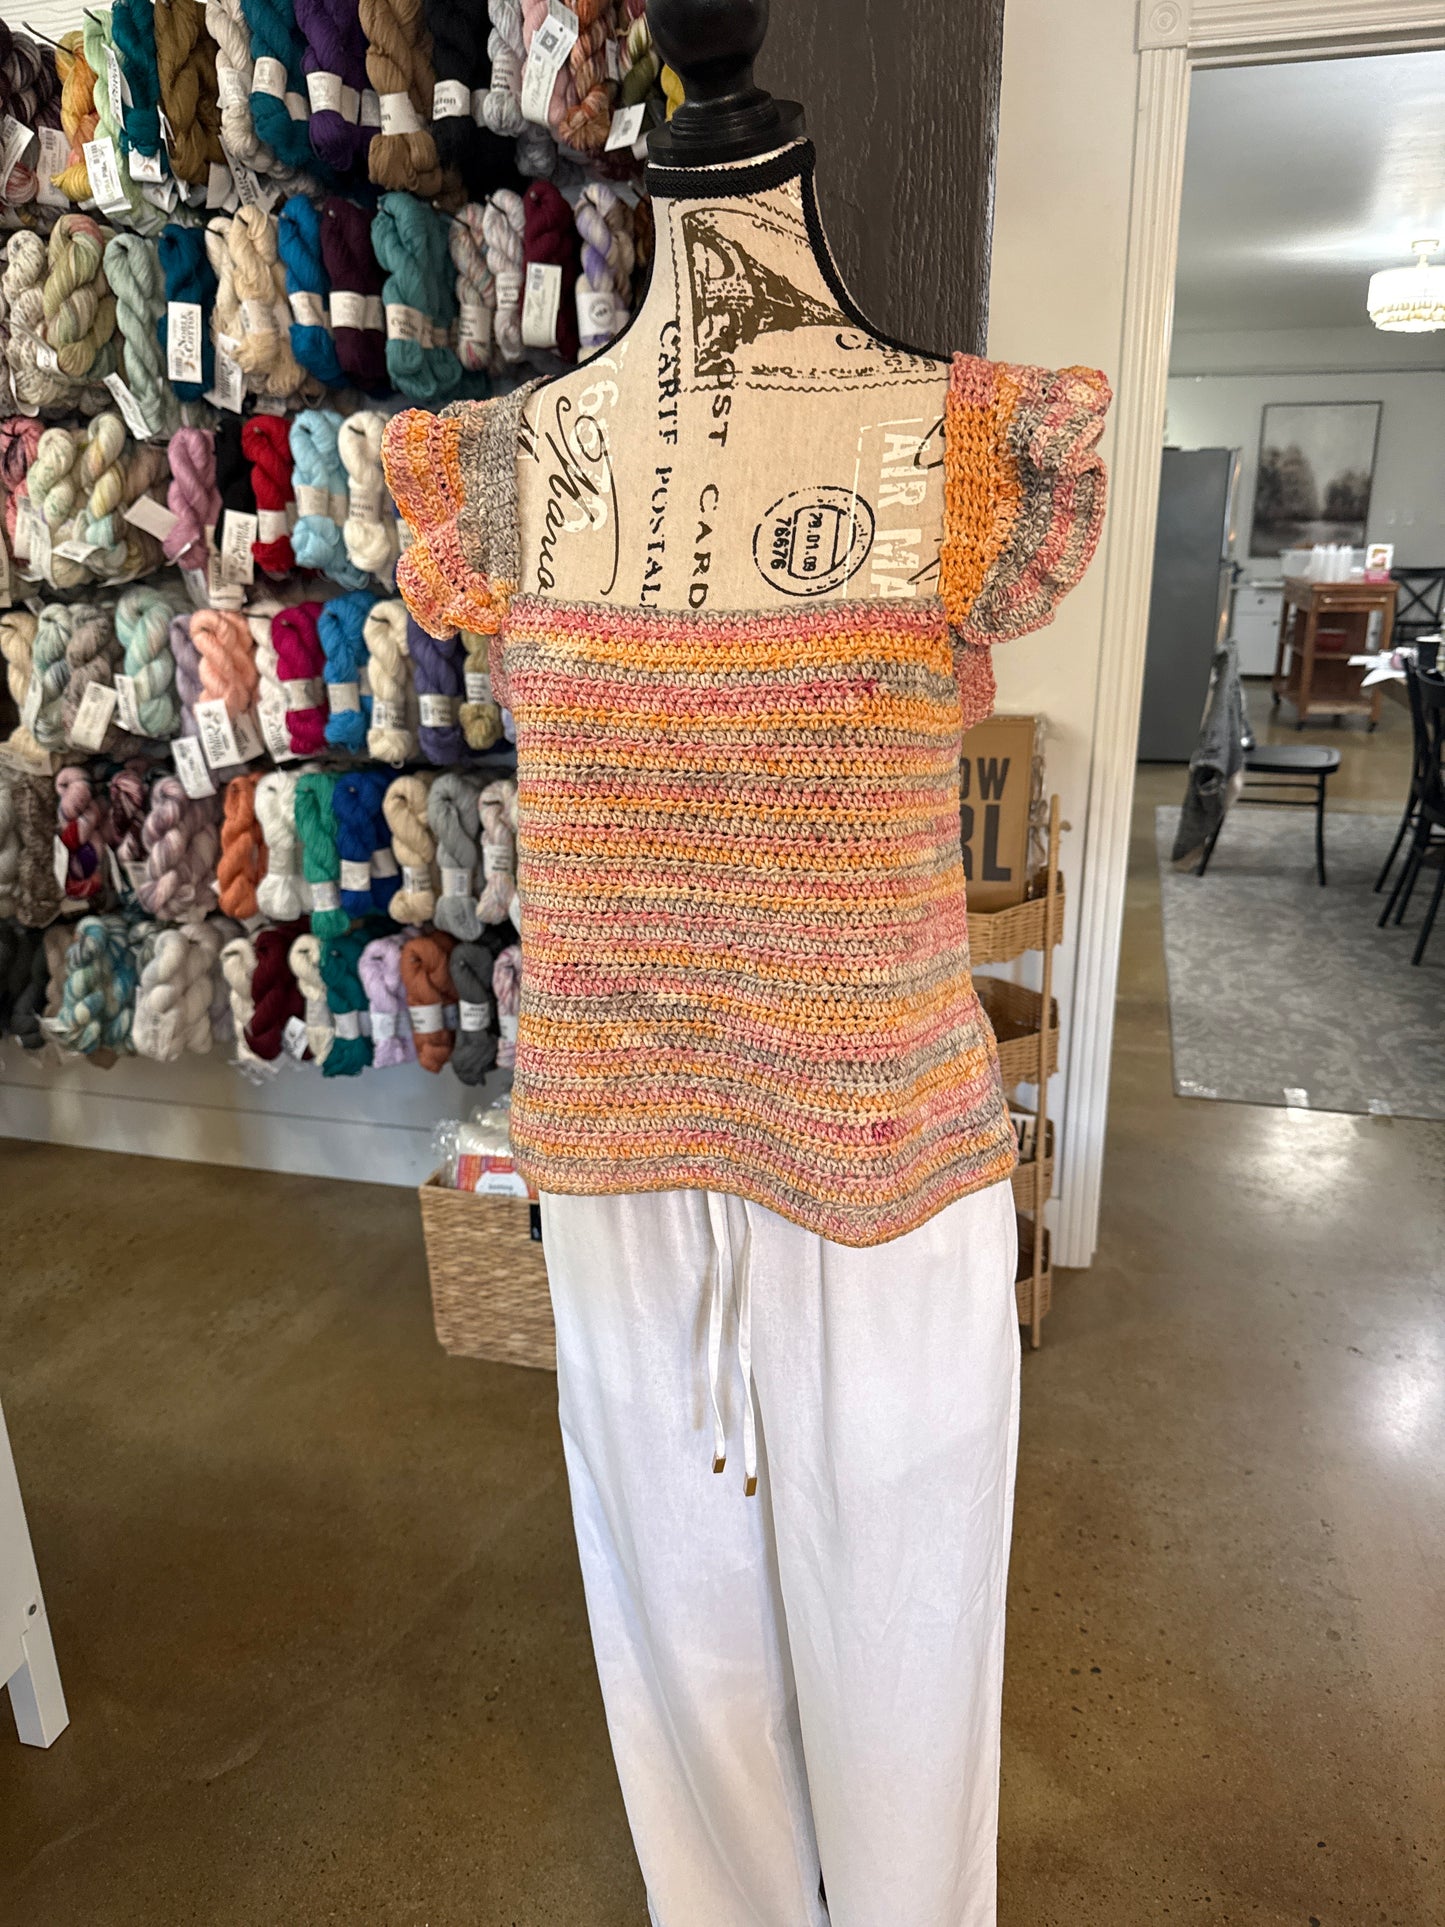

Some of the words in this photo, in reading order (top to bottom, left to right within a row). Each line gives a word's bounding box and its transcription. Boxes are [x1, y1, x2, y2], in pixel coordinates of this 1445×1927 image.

[877, 432, 931, 510] AIR
[687, 483, 720, 609] CARD
[770, 516, 793, 571] 76676
